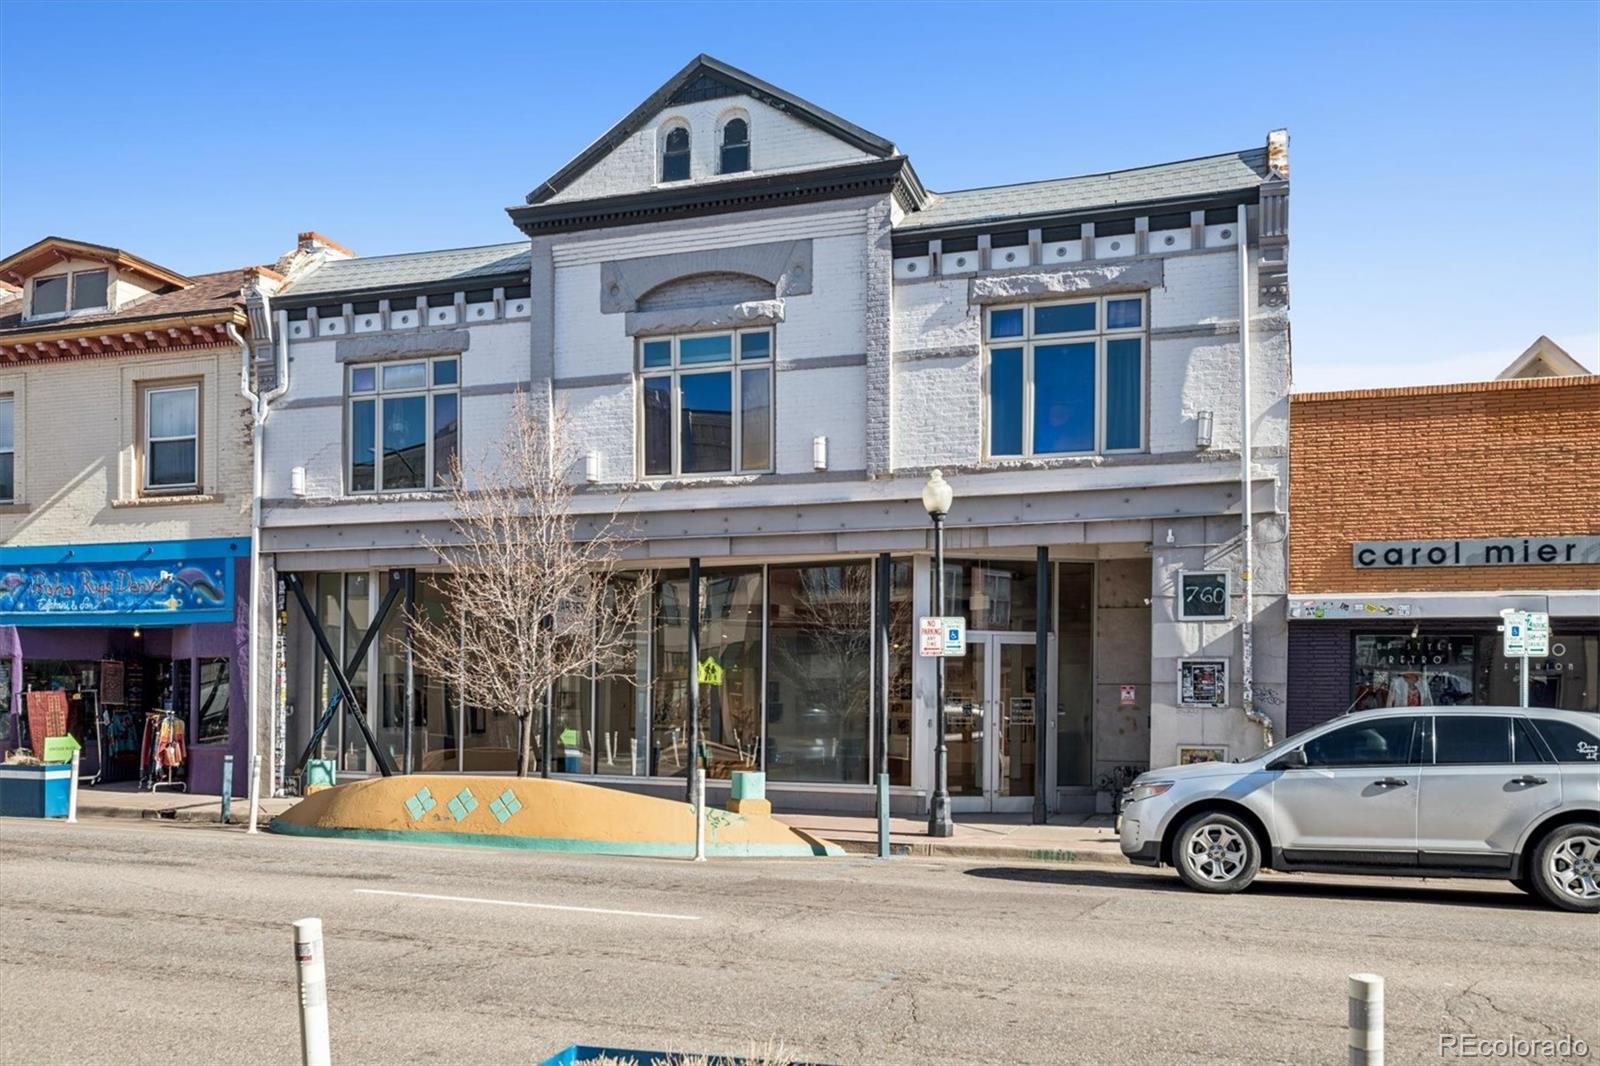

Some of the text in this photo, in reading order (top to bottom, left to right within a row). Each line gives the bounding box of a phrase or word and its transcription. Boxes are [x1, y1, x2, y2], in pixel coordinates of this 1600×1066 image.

[1357, 539, 1577, 566] carol mier
[1185, 586, 1225, 603] 760
[1388, 655, 1442, 664] RETRO
